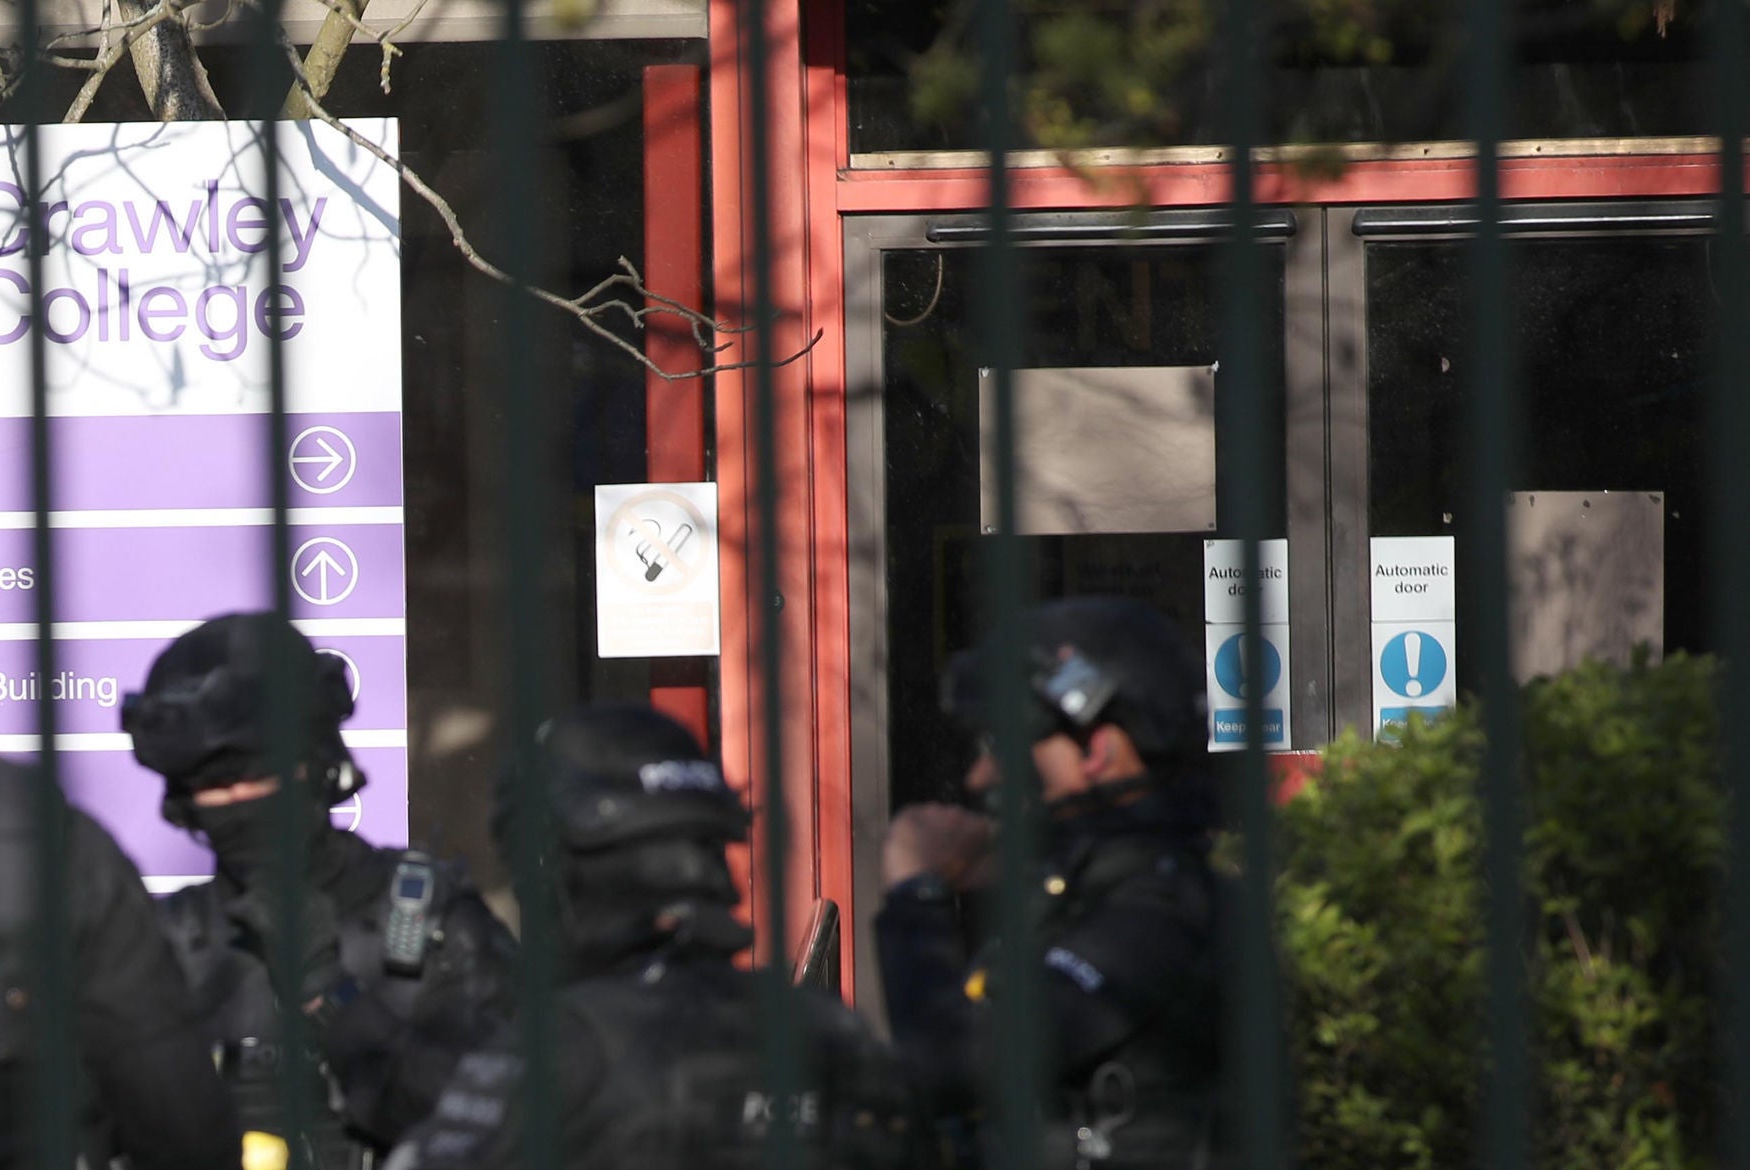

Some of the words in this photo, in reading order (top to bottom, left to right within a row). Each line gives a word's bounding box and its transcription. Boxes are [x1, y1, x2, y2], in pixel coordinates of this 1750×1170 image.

[1208, 565, 1283, 579] Autoatic
[1375, 563, 1449, 577] Automatic
[1394, 580, 1429, 594] door
